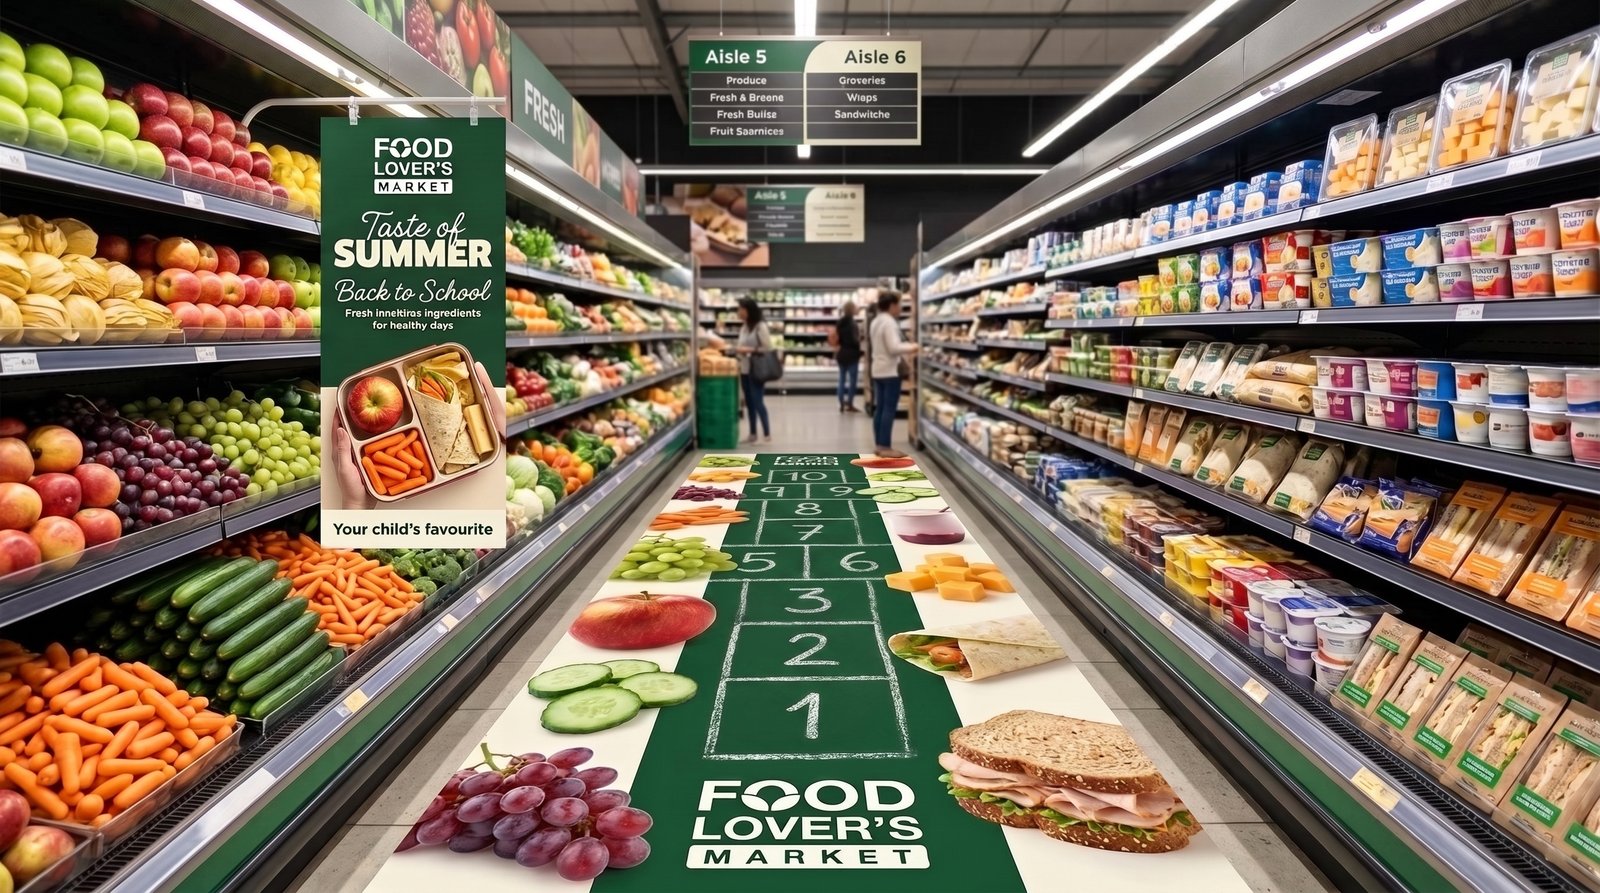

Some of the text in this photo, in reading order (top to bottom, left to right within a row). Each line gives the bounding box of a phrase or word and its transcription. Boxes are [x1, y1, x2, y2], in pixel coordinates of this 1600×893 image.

[706, 49, 766, 64] Aisle 5
[845, 50, 906, 64] Aisle 6
[727, 76, 767, 84] Produce
[711, 93, 737, 101] Fresh
[524, 78, 566, 145] FRESH
[717, 110, 744, 118] Fresh
[835, 110, 890, 118] Sandwitche
[710, 127, 733, 135] Fruit
[375, 138, 452, 158] FOOD
[375, 162, 452, 175] LOVER'S
[378, 182, 450, 192] MARKET
[362, 211, 466, 247] Taste of
[334, 238, 492, 268] SUMMER
[335, 279, 492, 302] Back to School
[346, 309, 372, 317] Fresh
[425, 309, 481, 319] ingredients
[373, 321, 453, 331] for healthy days
[784, 471, 828, 481] 10
[829, 485, 854, 497] 9
[794, 502, 823, 516] 8
[333, 523, 493, 535] Your child's favourite
[792, 524, 824, 541] 7
[737, 552, 777, 573] 5
[839, 551, 880, 573] 6
[784, 587, 832, 614] 3
[784, 632, 840, 666] 2
[786, 692, 821, 740] 1
[697, 779, 916, 812] FOOD
[691, 815, 924, 841] LOVER'S
[703, 849, 912, 865] MARKET
